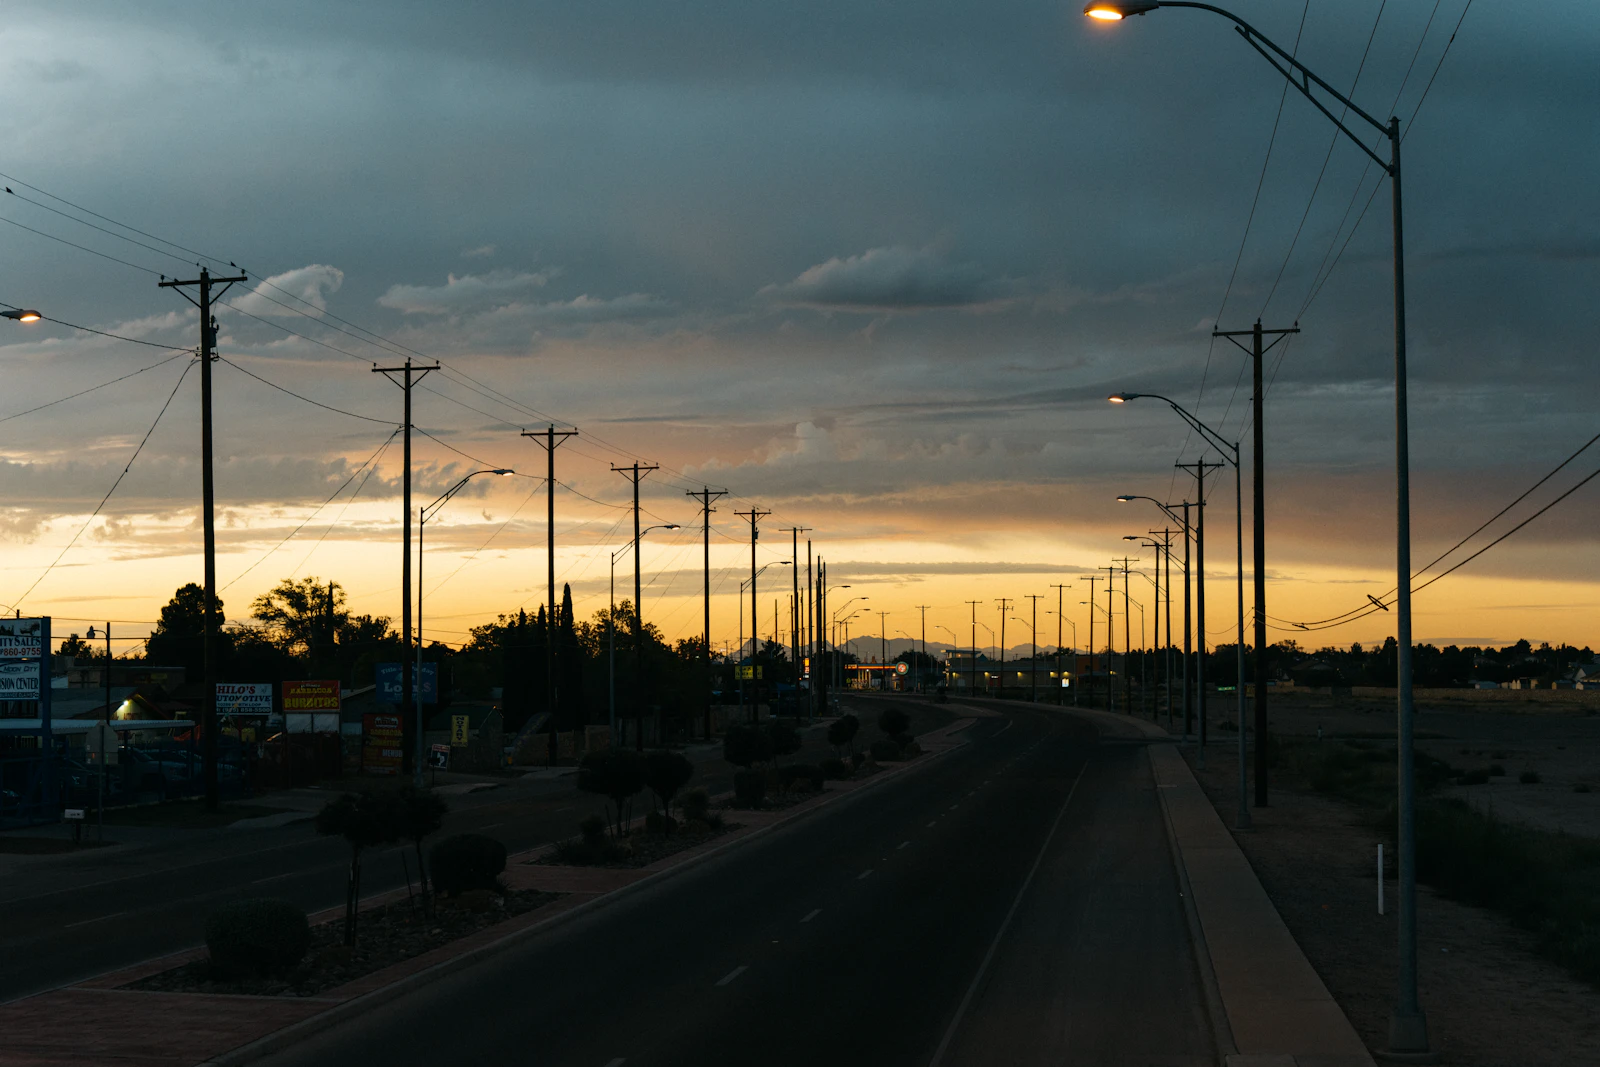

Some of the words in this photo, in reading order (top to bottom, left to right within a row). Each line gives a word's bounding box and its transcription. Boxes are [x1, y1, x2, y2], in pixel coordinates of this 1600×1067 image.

[14, 636, 41, 647] SALES
[3, 647, 41, 656] 860-9755
[16, 677, 39, 690] CENTER
[284, 697, 339, 709] BURRITOS
[455, 716, 465, 741] NOTARY
